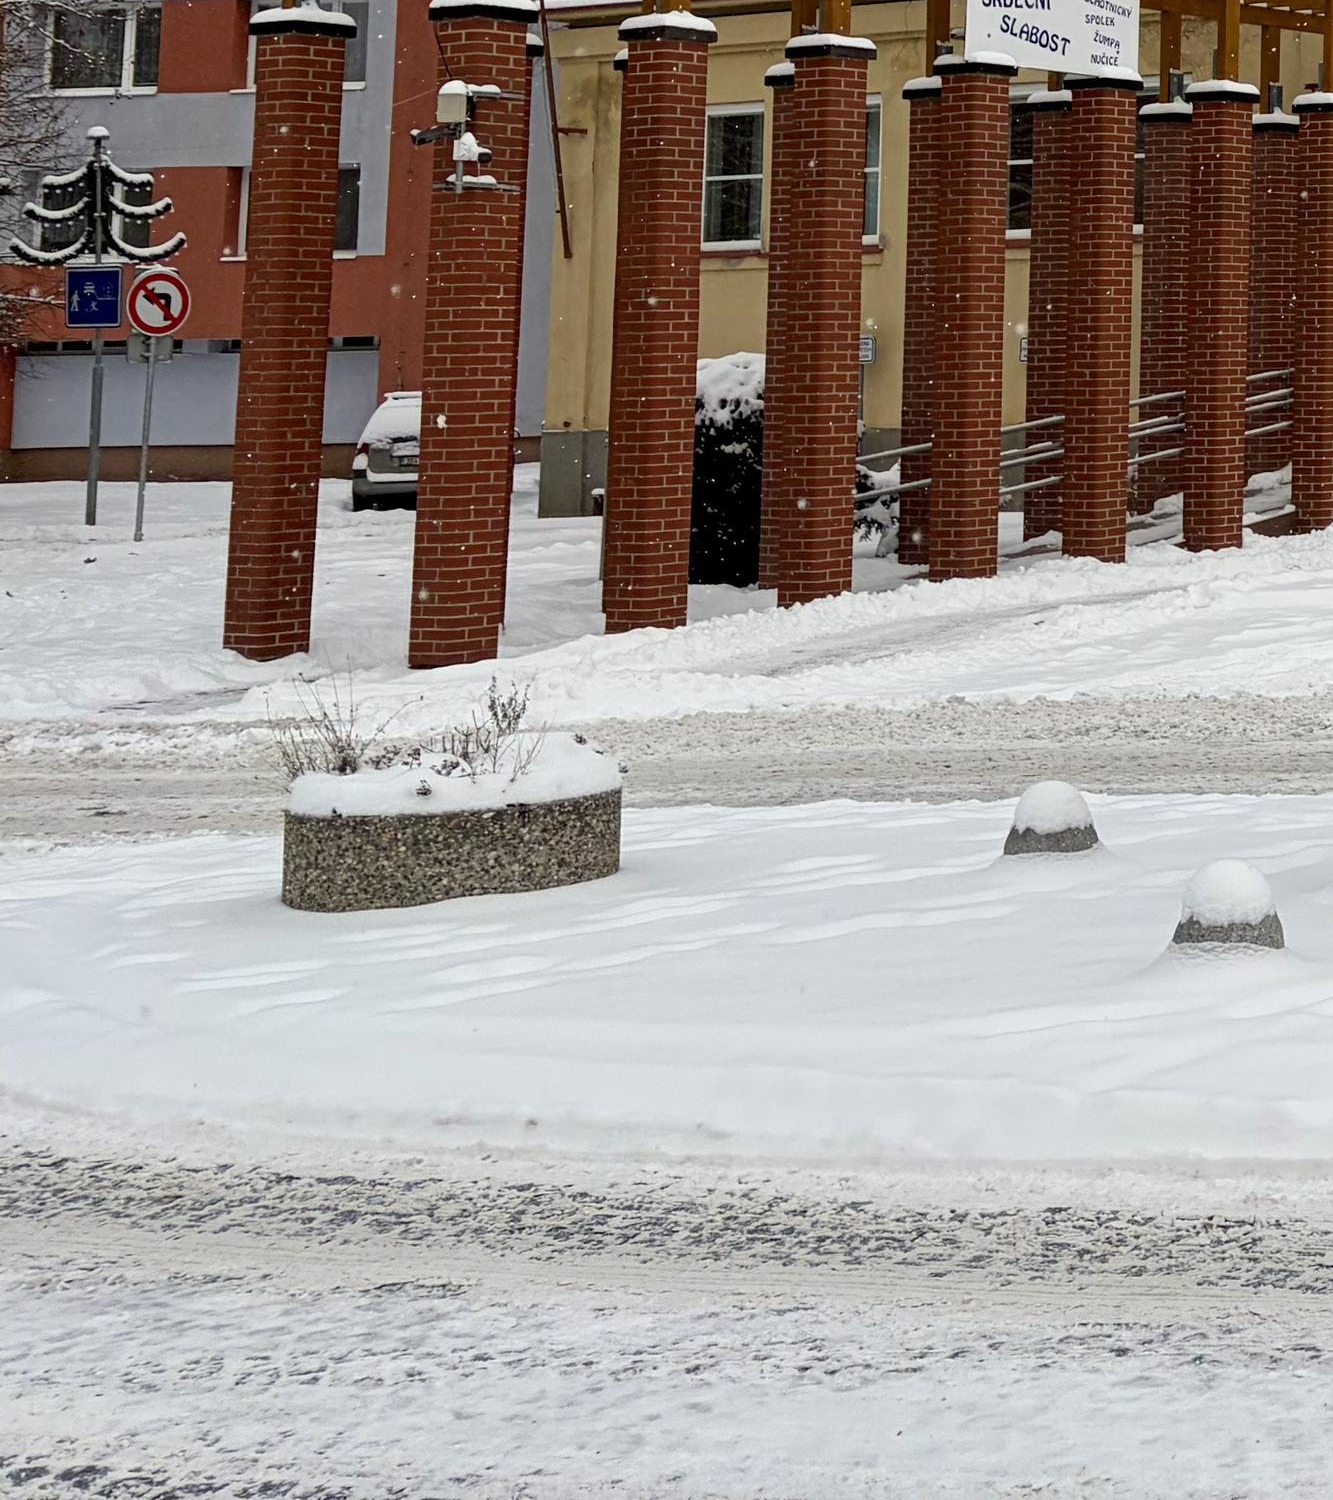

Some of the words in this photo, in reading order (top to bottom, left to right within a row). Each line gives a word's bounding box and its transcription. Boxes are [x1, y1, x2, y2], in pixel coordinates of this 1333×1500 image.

[1085, 14, 1115, 27] SPOLEK
[1000, 14, 1071, 56] SLABOST
[1093, 31, 1120, 50] ŽUMPA
[1090, 52, 1119, 67] NUČICE
